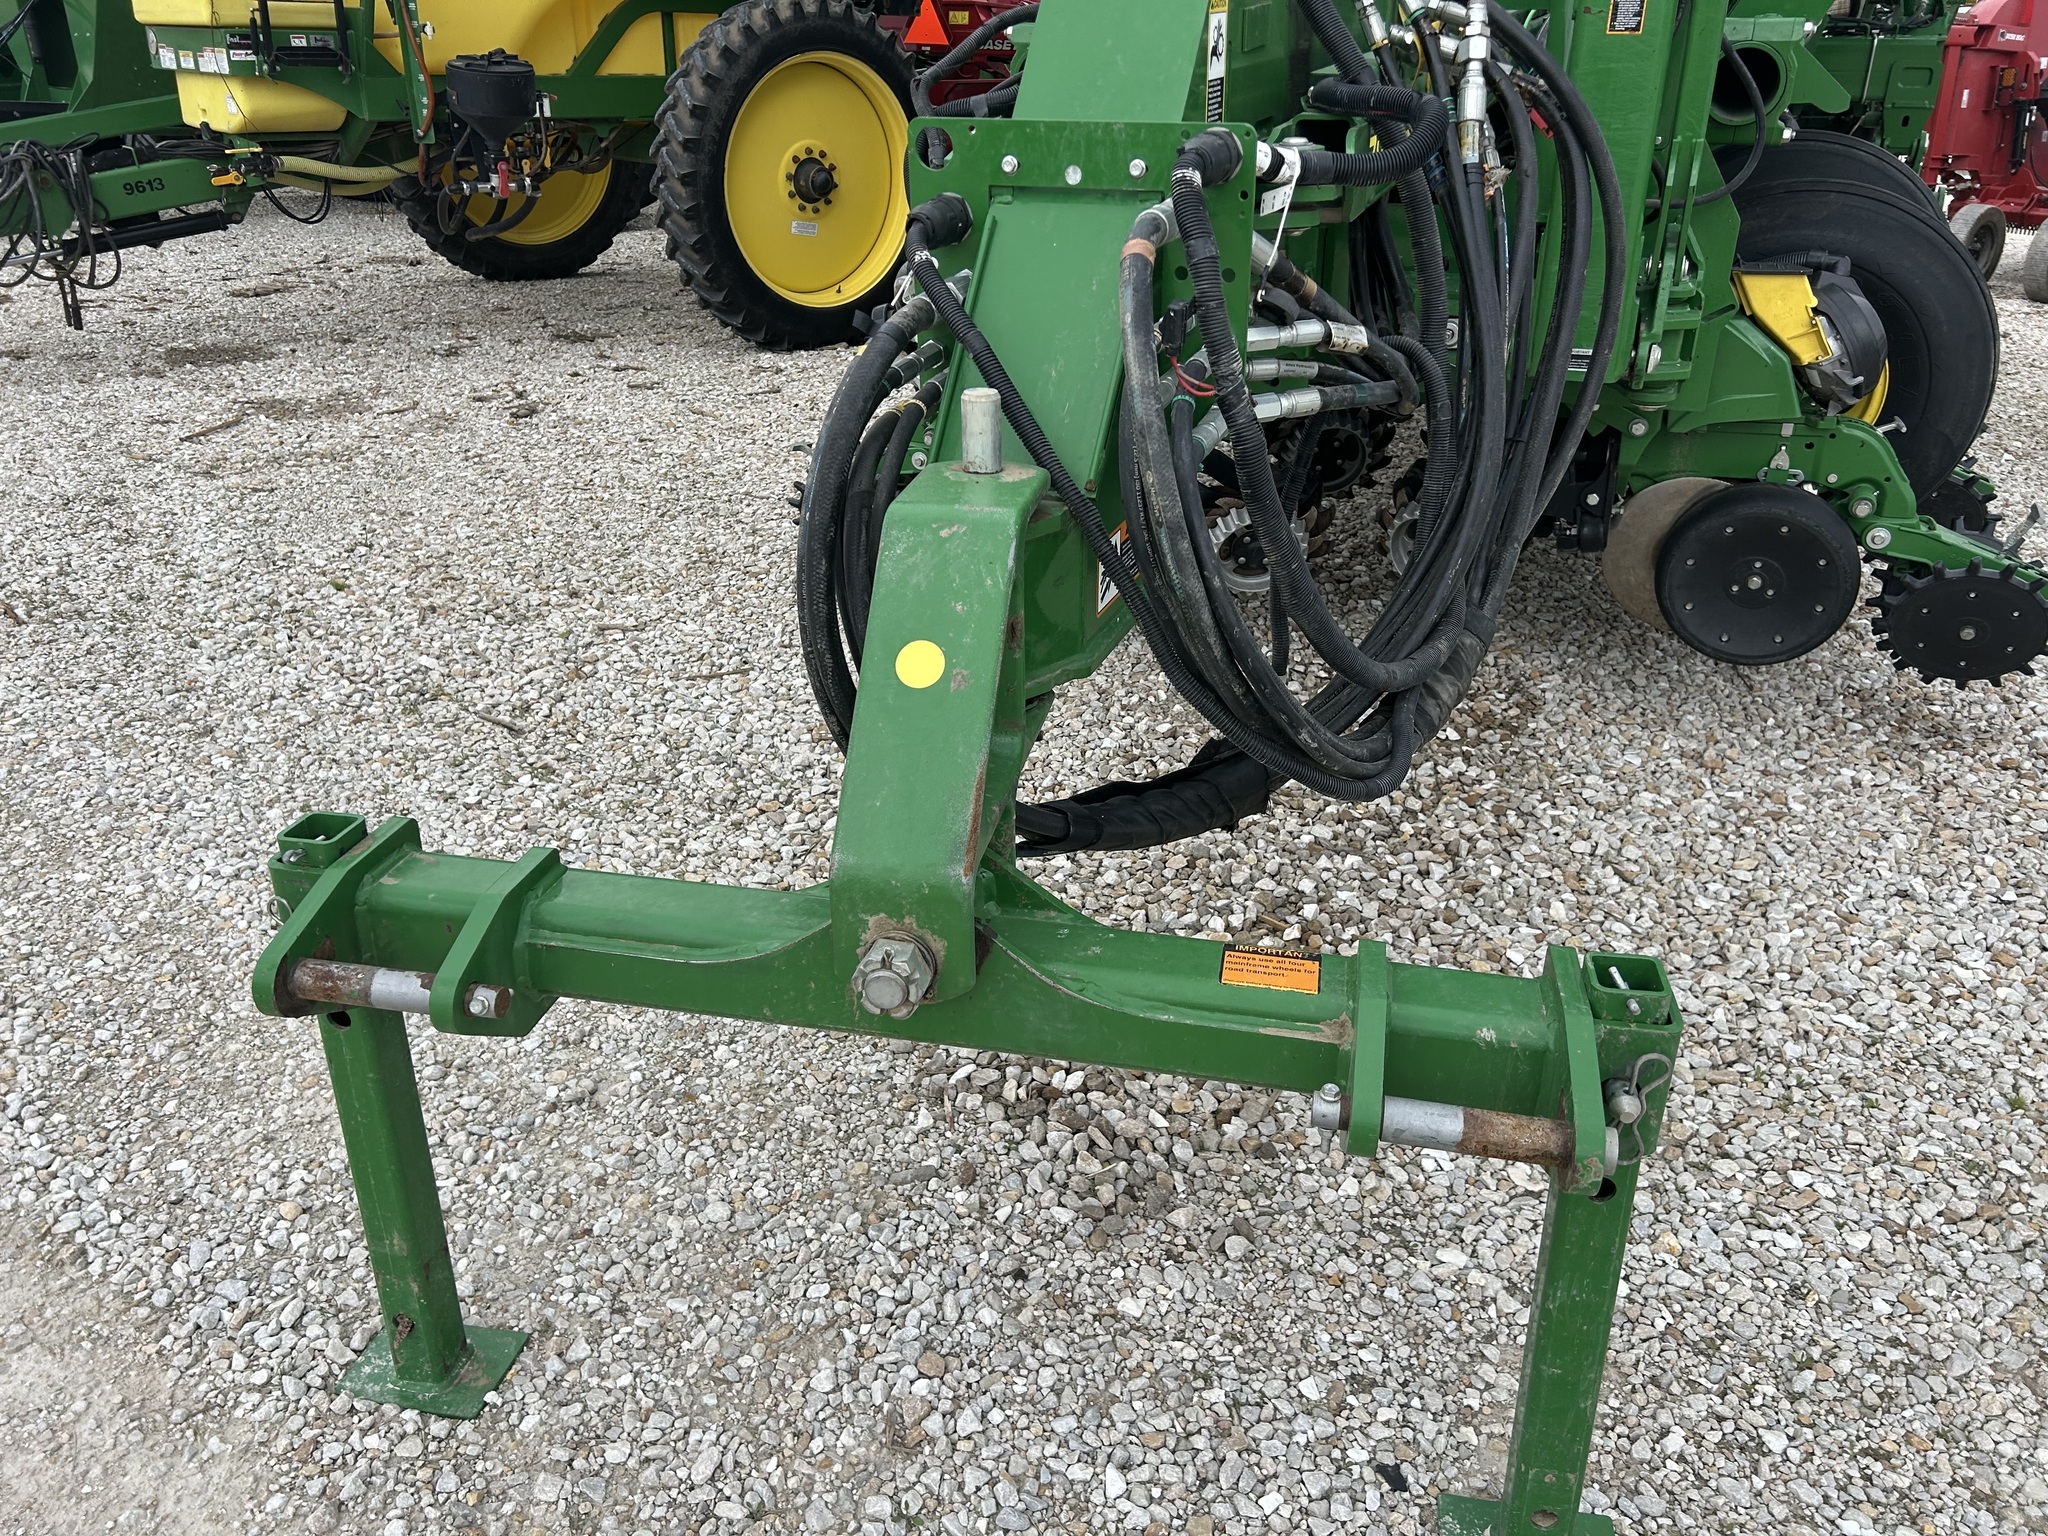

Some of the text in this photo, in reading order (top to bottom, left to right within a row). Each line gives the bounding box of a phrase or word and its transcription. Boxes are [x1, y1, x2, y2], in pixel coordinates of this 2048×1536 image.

[979, 39, 1012, 50] ASE
[123, 177, 165, 196] 9613
[1226, 953, 1257, 962] Always
[1225, 960, 1270, 969] mainframe
[1272, 965, 1302, 973] wheels
